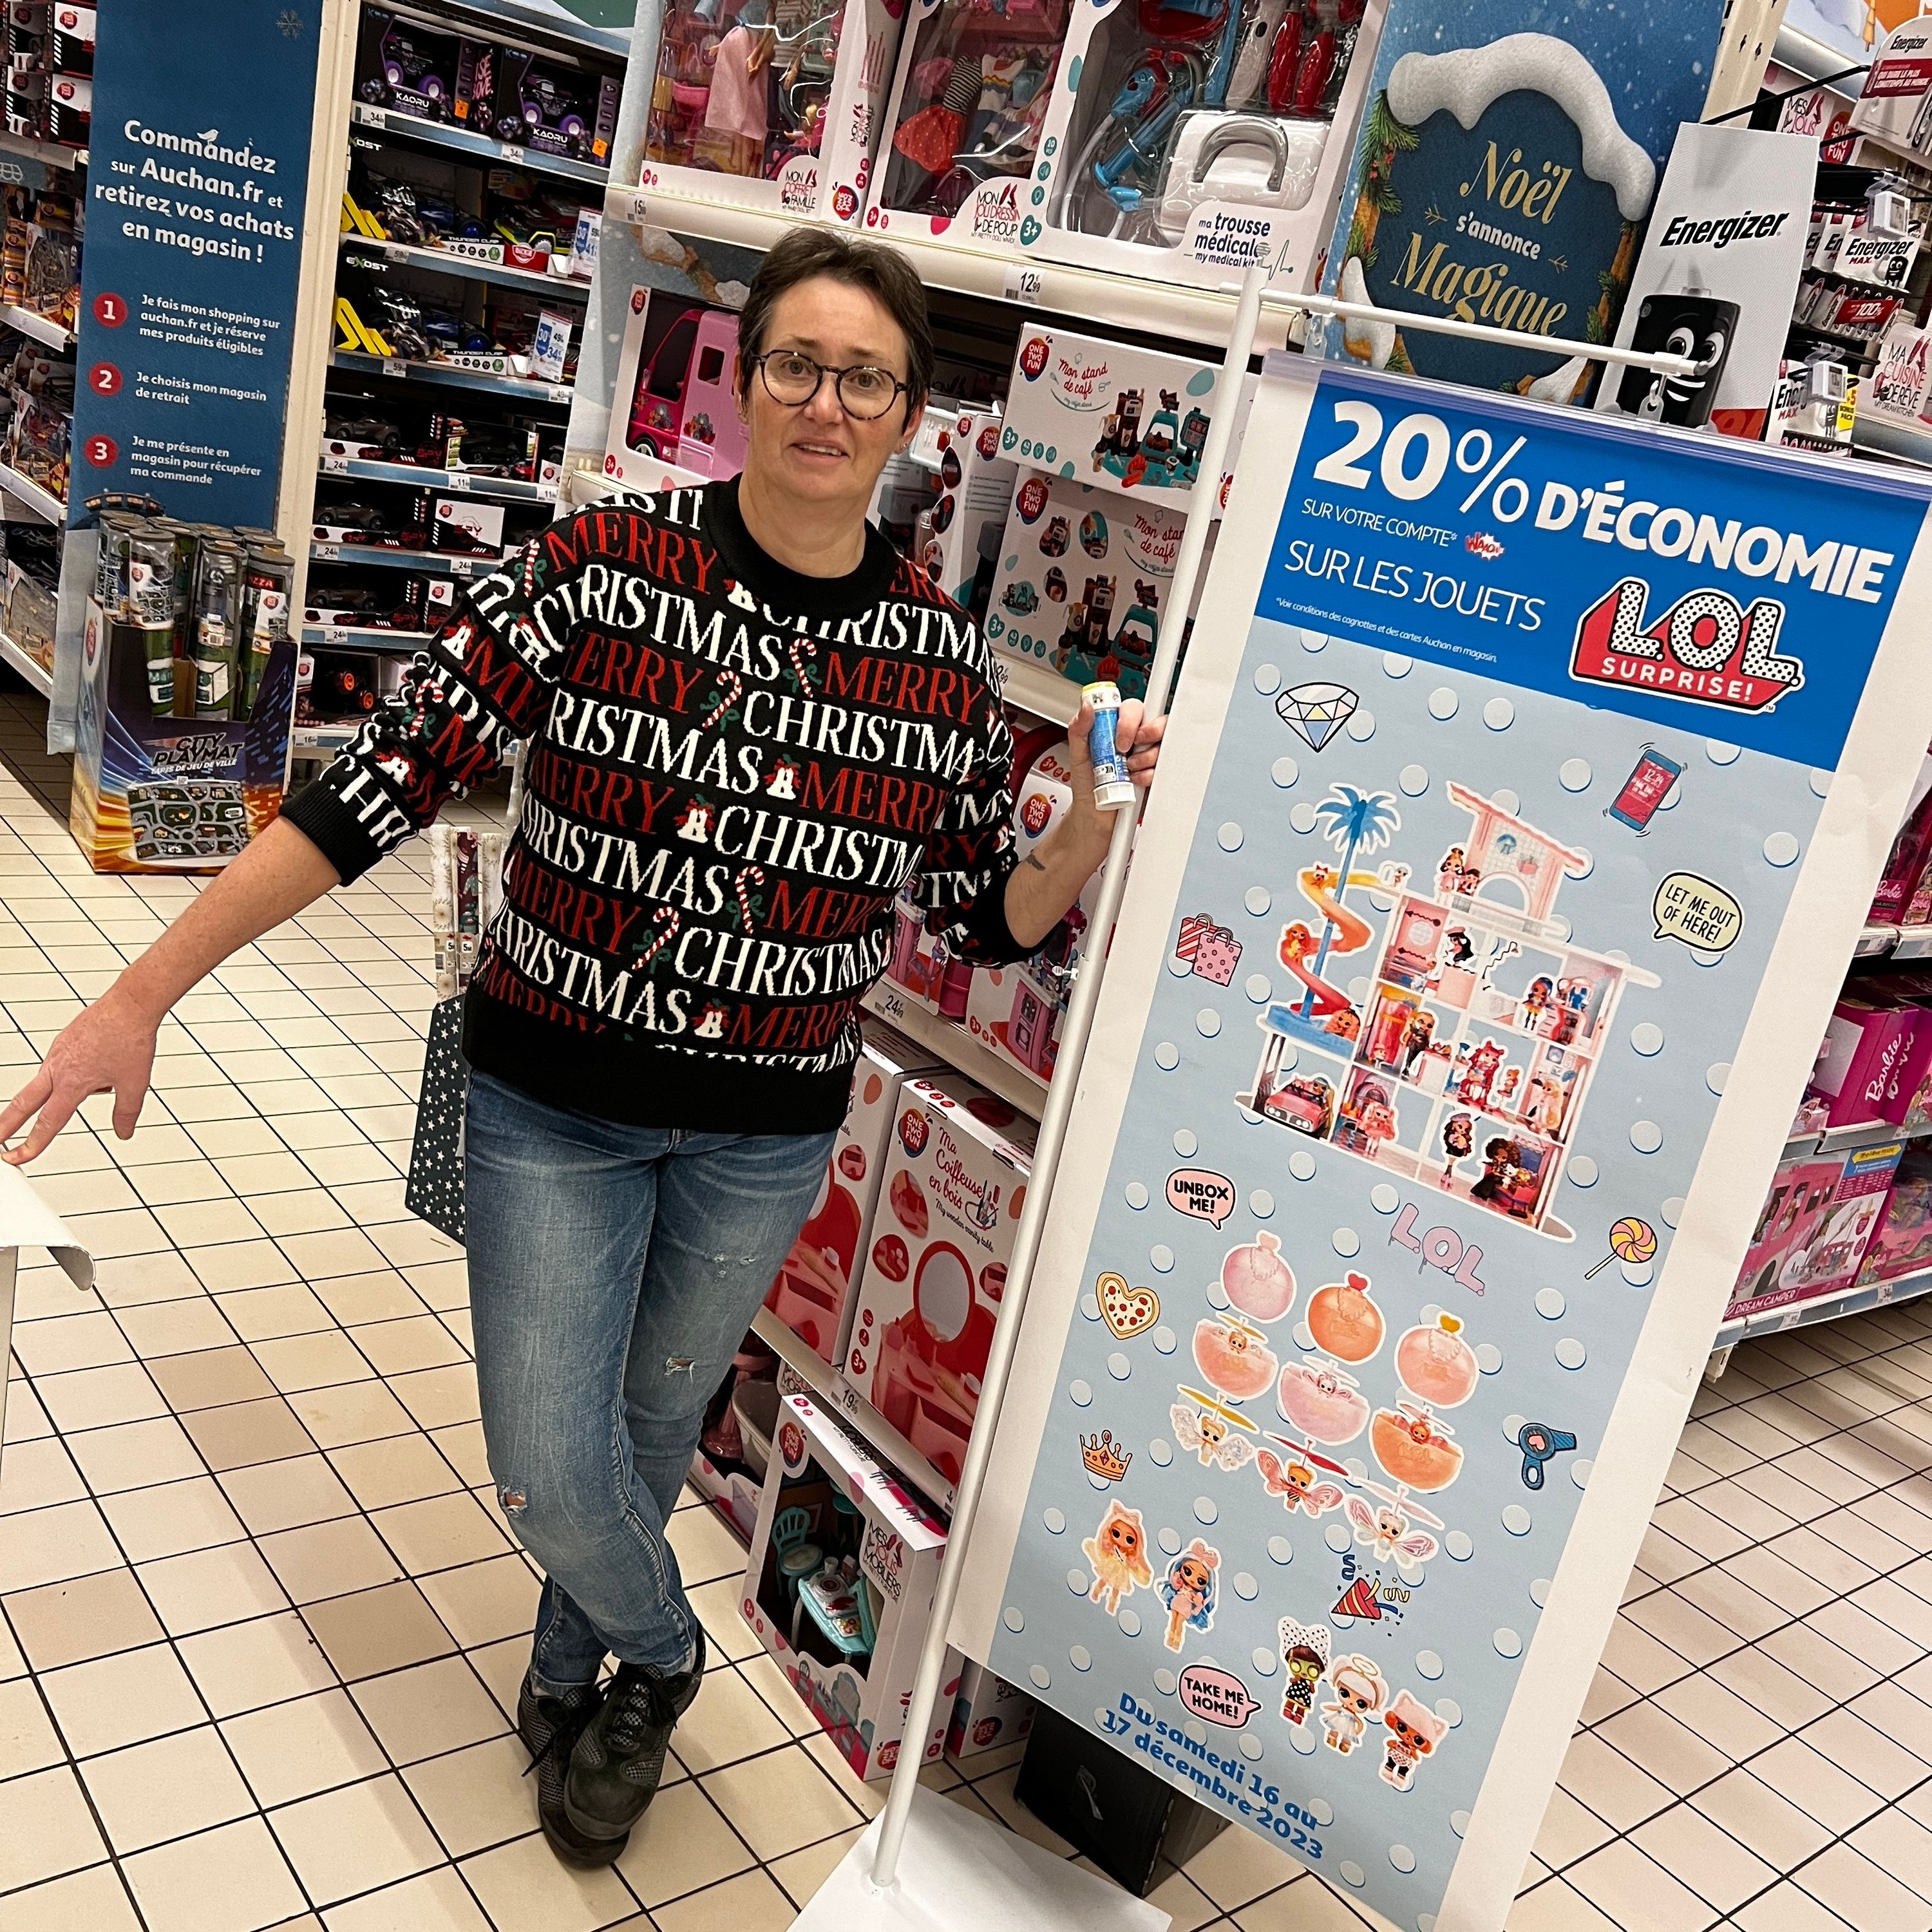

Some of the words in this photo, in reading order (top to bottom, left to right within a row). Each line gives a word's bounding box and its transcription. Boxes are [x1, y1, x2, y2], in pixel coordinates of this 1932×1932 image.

[1889, 35, 1929, 53] Energizer
[396, 92, 430, 108] KAORU
[124, 120, 276, 175] Commandez
[533, 128, 568, 143] KAORU
[111, 158, 135, 175] sur
[140, 158, 263, 203] Auchan.fr
[268, 194, 283, 209] et
[786, 171, 804, 182] MON
[1459, 140, 1573, 224] Noël
[791, 194, 816, 209] FAMILLE
[977, 191, 999, 205] MON
[95, 183, 171, 214] retirez
[176, 202, 213, 223] vos
[220, 211, 294, 241] achats
[1198, 220, 1212, 228] ma
[1215, 212, 1271, 236] trousse
[983, 219, 993, 233] DE
[1023, 222, 1038, 236] 3+
[1456, 211, 1540, 259] s'annonce
[1660, 211, 1790, 249] Energizer
[122, 222, 149, 241] en
[155, 229, 251, 261] magasin
[256, 245, 263, 263] !
[1845, 238, 1914, 259] Energizer
[346, 256, 389, 272] EXOST
[1195, 252, 1208, 264] my
[1208, 254, 1242, 267] medical
[1242, 258, 1255, 268] kit
[1390, 231, 1568, 336] Magique
[104, 301, 116, 320] 1
[142, 295, 155, 306] Je
[156, 297, 180, 310] fais
[181, 303, 206, 316] mon
[209, 307, 260, 328] shopping
[263, 318, 280, 329] sur
[140, 311, 198, 330] auchan.fr
[200, 323, 211, 332] et
[213, 322, 223, 335] je
[225, 325, 267, 341] réserve
[140, 328, 164, 339] mes
[166, 331, 214, 348] produits
[216, 339, 263, 356] éligibles
[1029, 344, 1044, 355] ONE
[1888, 342, 1906, 361] MA
[1027, 359, 1041, 370] FUN
[1028, 352, 1043, 363] TWO
[1059, 358, 1077, 379] Mon
[1081, 361, 1108, 380] stand
[98, 370, 112, 388] 2
[137, 372, 149, 383] Je
[151, 375, 191, 389] choisis
[193, 381, 218, 393] mon
[219, 384, 267, 402] magasin
[1884, 361, 1927, 389] CUISINE
[136, 388, 151, 399] de
[153, 390, 189, 404] retrait
[1064, 378, 1074, 392] de
[1075, 380, 1093, 400] café
[132, 436, 145, 447] Je
[147, 439, 164, 450] me
[167, 442, 214, 458] présente
[217, 449, 229, 458] en
[1005, 433, 1016, 444] 3+
[95, 443, 108, 460] 3
[1313, 401, 1530, 523] 20%
[130, 468, 149, 477] ma
[151, 469, 213, 485] commande
[131, 452, 180, 468] magasin
[183, 459, 209, 471] pour
[211, 460, 262, 478] récupérer
[1025, 494, 1041, 504] TWO
[1026, 485, 1043, 497] ONE
[1024, 502, 1040, 513] FUN
[1302, 498, 1333, 520] SUR
[1336, 507, 1385, 532] VOTRE
[1134, 514, 1158, 538] Mon
[544, 512, 717, 594] MERRY
[1140, 538, 1151, 554] de
[1153, 543, 1175, 564] café
[1535, 480, 1895, 604] D'ÉCONOMIE
[1285, 540, 1347, 584] SUR
[1352, 556, 1413, 598] LES
[1414, 571, 1545, 631] JOUETS
[990, 620, 1002, 632] 3+
[1293, 603, 1328, 618] conditions
[1329, 611, 1341, 621] des
[1342, 616, 1377, 631] cagnottes
[1378, 625, 1385, 633] et
[1385, 627, 1399, 637] des
[1399, 632, 1421, 643] cartes
[1422, 636, 1452, 650] Auchan
[822, 651, 985, 725] MERRY
[1602, 657, 1753, 703] SURPRISE!
[176, 732, 226, 752] CITY
[743, 690, 975, 785] CHRISTMA
[153, 743, 245, 766] PLAYMAT
[216, 759, 237, 767] VILLE
[1030, 799, 1046, 813] ONE
[1030, 806, 1044, 820] TWO
[1027, 815, 1042, 828] FUN
[522, 789, 729, 916] CHRISTMAS
[510, 849, 642, 955] MERRY
[1665, 884, 1690, 907] LET
[1688, 896, 1710, 914] ME
[1709, 905, 1736, 927] OUT
[1663, 905, 1679, 922] OF
[1681, 915, 1722, 943] HERE!
[488, 897, 692, 1034] CHRISTMAS
[674, 926, 883, 996] CHRISTMAS
[1865, 1033, 1902, 1101] Barbie
[906, 1121, 922, 1139] TWO
[907, 1113, 923, 1128] ONE
[905, 1132, 921, 1148] FUN
[940, 1127, 957, 1155] Ma
[936, 1148, 983, 1198] Coiffeuse
[929, 1175, 941, 1192] en
[943, 1179, 962, 1209] bois
[1173, 1180, 1229, 1200] UNBOX
[1189, 1197, 1215, 1214] ME!
[1735, 1298, 1763, 1314] DREAM
[1763, 1289, 1796, 1307] CAMPER
[869, 1518, 888, 1546] MES
[875, 1542, 898, 1576] JOLIS
[1184, 1677, 1221, 1700] TAKE
[1225, 1689, 1244, 1705] ME
[1191, 1696, 1239, 1719] HOME!
[1119, 1692, 1152, 1726] Du
[1155, 1721, 1244, 1784] samedi
[1249, 1774, 1279, 1805] 16
[1284, 1801, 1318, 1832] au
[1104, 1709, 1132, 1736] 17
[1135, 1733, 1252, 1815] décembre
[1258, 1806, 1323, 1860] 2023
